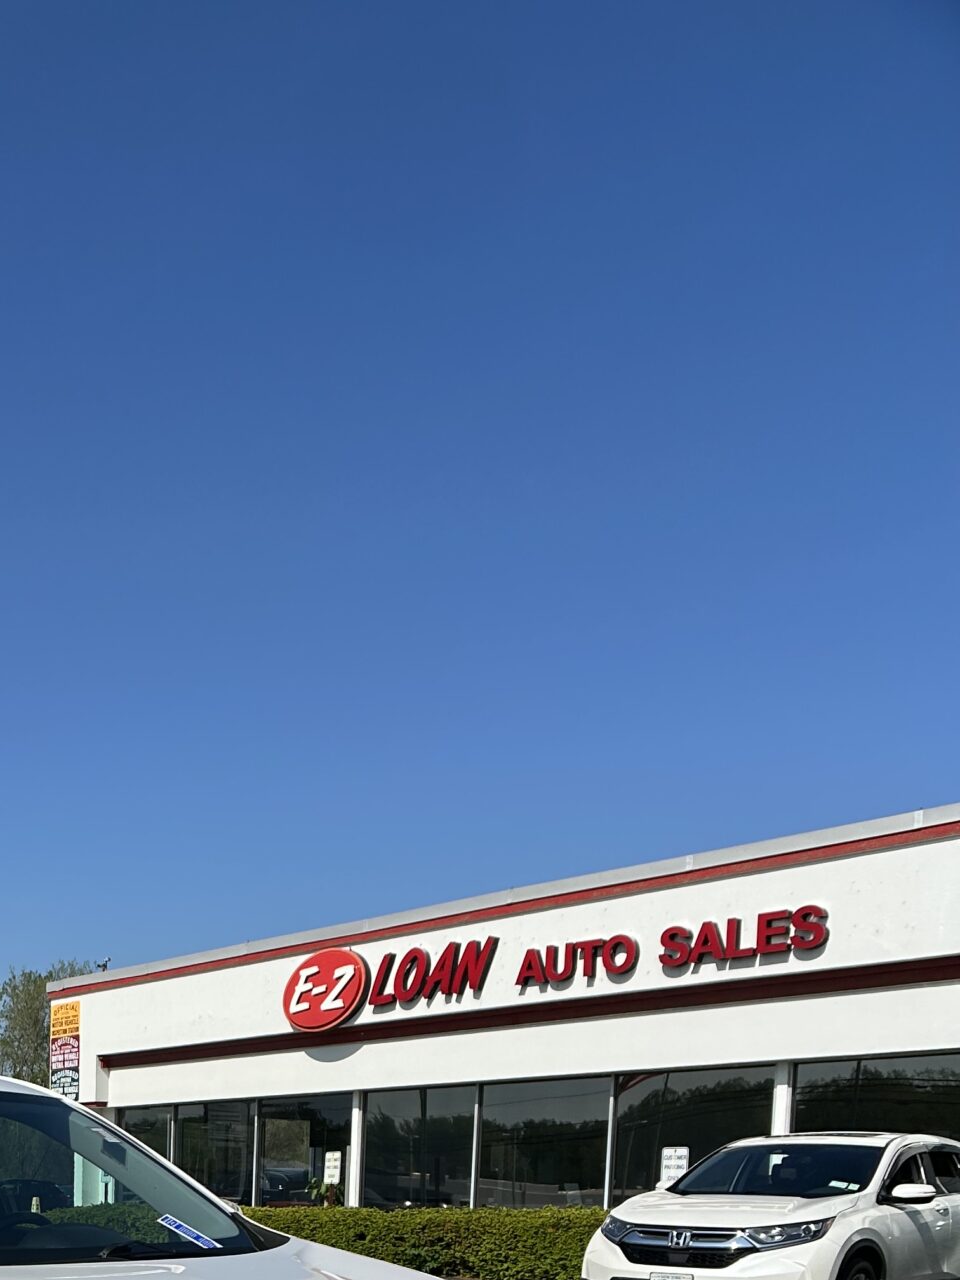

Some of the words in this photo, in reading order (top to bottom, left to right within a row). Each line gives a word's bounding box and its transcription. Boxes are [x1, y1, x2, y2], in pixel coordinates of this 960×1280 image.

[289, 964, 355, 1014] E-Z
[368, 935, 498, 1006] LOAN
[514, 933, 639, 987] AUTO
[658, 904, 828, 967] SALES
[53, 1003, 78, 1016] OFFICIAL
